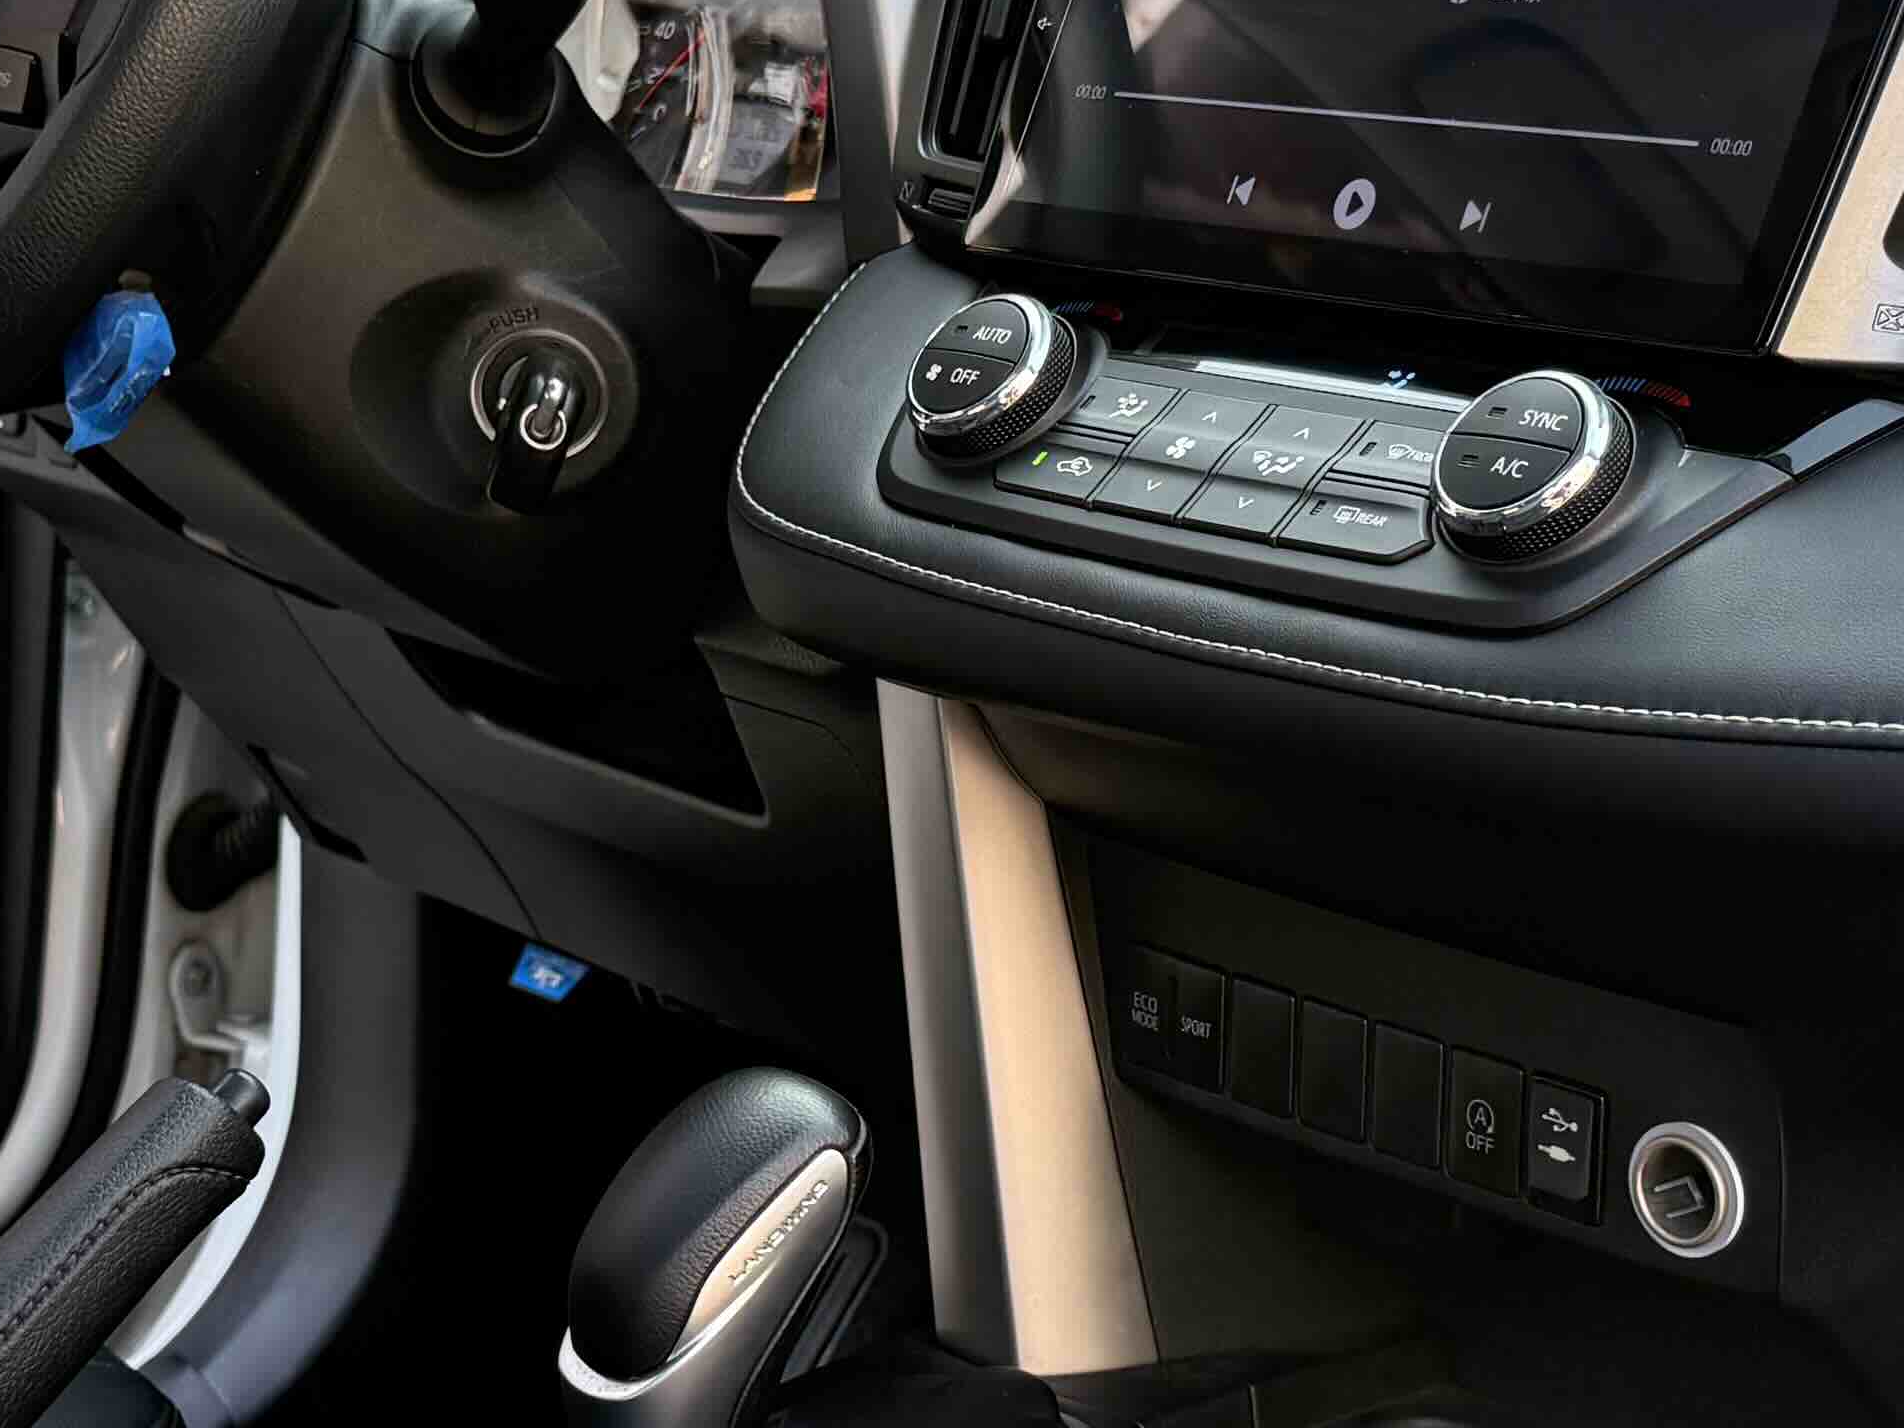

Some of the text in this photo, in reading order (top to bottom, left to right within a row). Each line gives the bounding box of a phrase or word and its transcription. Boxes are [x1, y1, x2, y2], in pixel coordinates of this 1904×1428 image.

[654, 20, 677, 40] 40
[1709, 137, 1753, 157] 00:00
[487, 306, 541, 333] PUSH
[972, 325, 1013, 345] AUTO
[949, 367, 981, 386] OFF
[1517, 409, 1569, 432] SYNC
[1490, 456, 1529, 478] A/C
[1356, 509, 1388, 528] REAR
[1133, 991, 1158, 1014] ECO
[1131, 1007, 1159, 1032] MODE
[1180, 1015, 1213, 1040] SPORT
[1465, 1131, 1495, 1155] OFF
